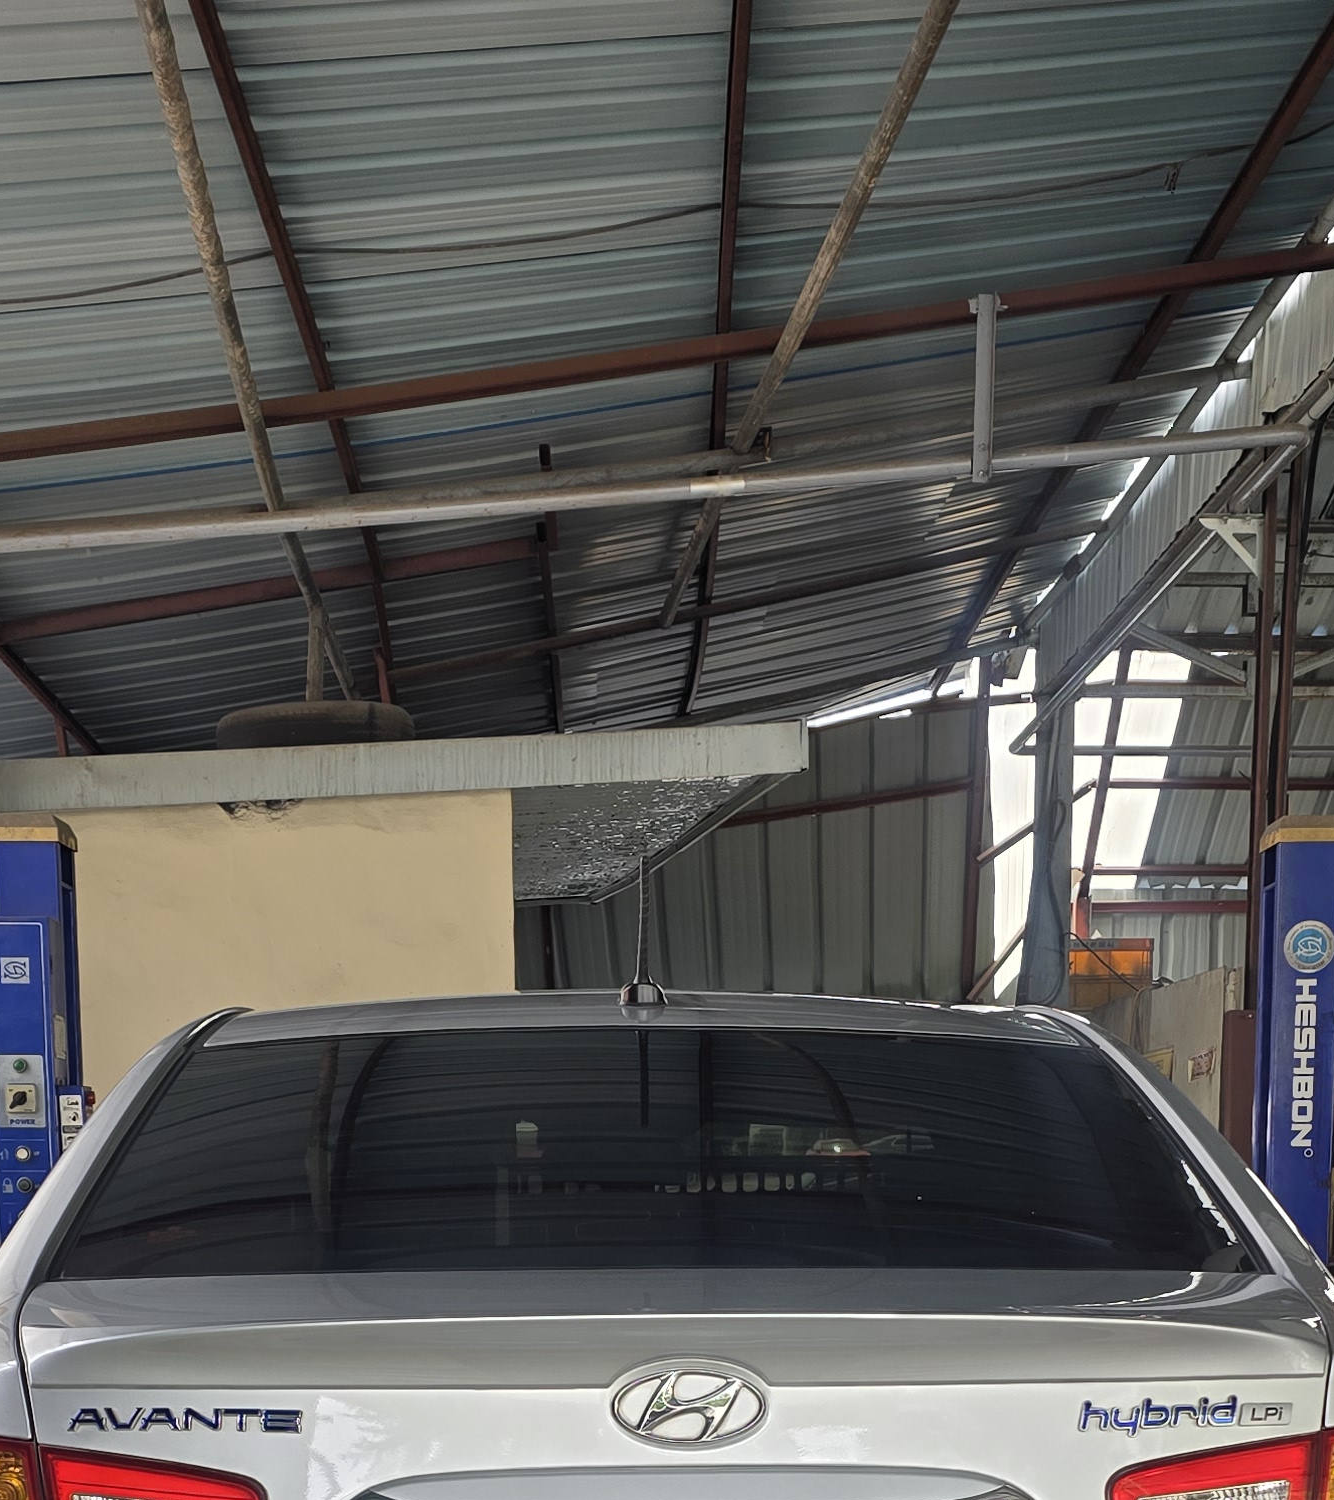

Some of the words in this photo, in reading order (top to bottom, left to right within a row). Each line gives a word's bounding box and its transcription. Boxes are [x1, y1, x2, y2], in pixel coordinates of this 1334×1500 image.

[1290, 978, 1318, 1148] HESHBON
[67, 1406, 304, 1434] AVANTE
[1078, 1394, 1238, 1438] hybrid
[1250, 1406, 1284, 1421] LPi
